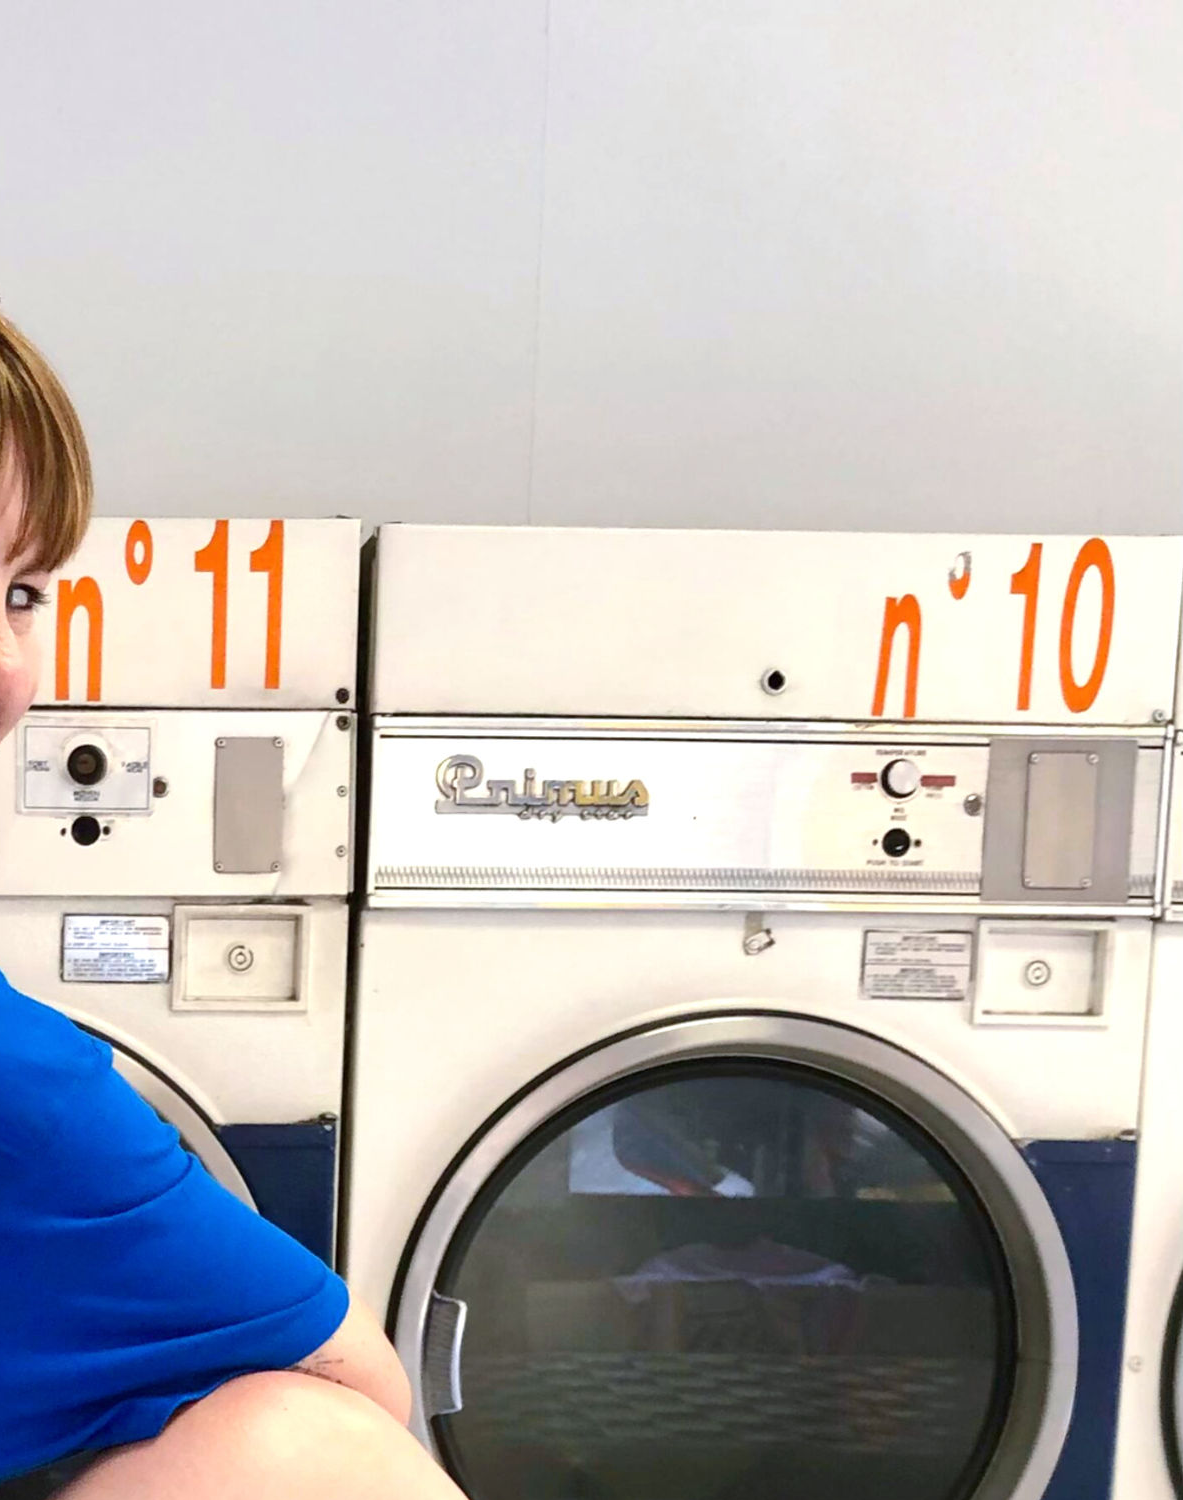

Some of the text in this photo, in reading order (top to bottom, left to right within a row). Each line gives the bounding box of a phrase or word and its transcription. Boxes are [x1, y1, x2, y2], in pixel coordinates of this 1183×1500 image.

[194, 519, 284, 690] 11
[1010, 537, 1115, 713] 10
[435, 754, 649, 806] Primus
